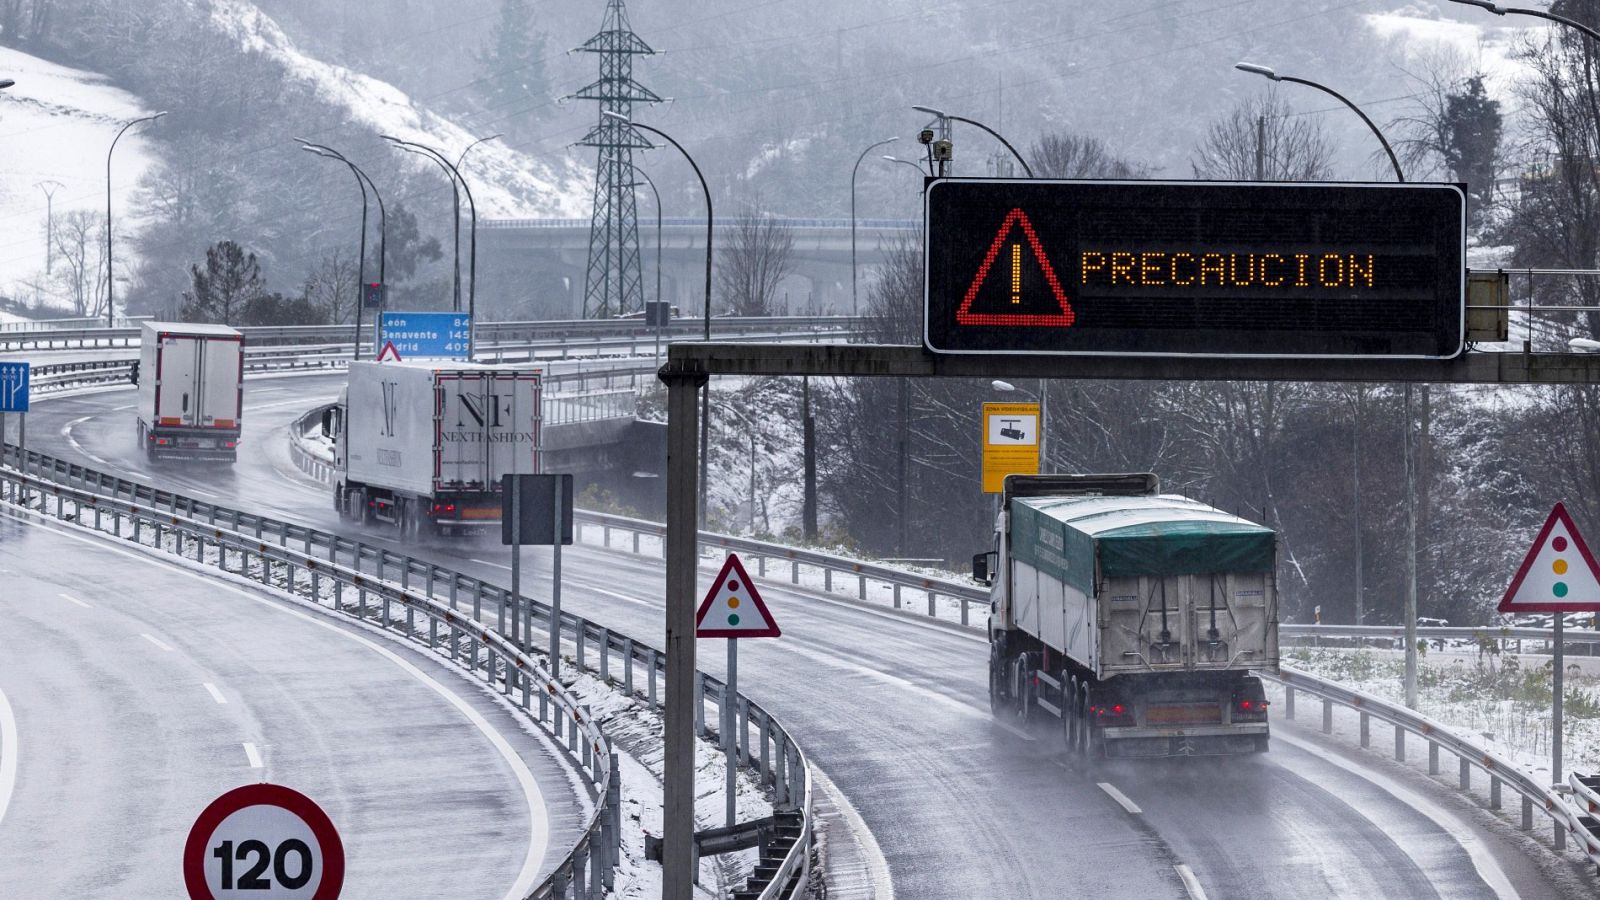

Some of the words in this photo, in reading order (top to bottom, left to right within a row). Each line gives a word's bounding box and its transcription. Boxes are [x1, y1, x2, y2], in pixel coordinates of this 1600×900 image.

[1081, 251, 1374, 287] PRECAUCION
[454, 318, 470, 327] 84
[382, 330, 438, 339] Benavente
[449, 330, 470, 339] 145
[444, 342, 470, 351] 409
[441, 431, 535, 443] NEXTFASHION
[214, 838, 313, 890] 120
